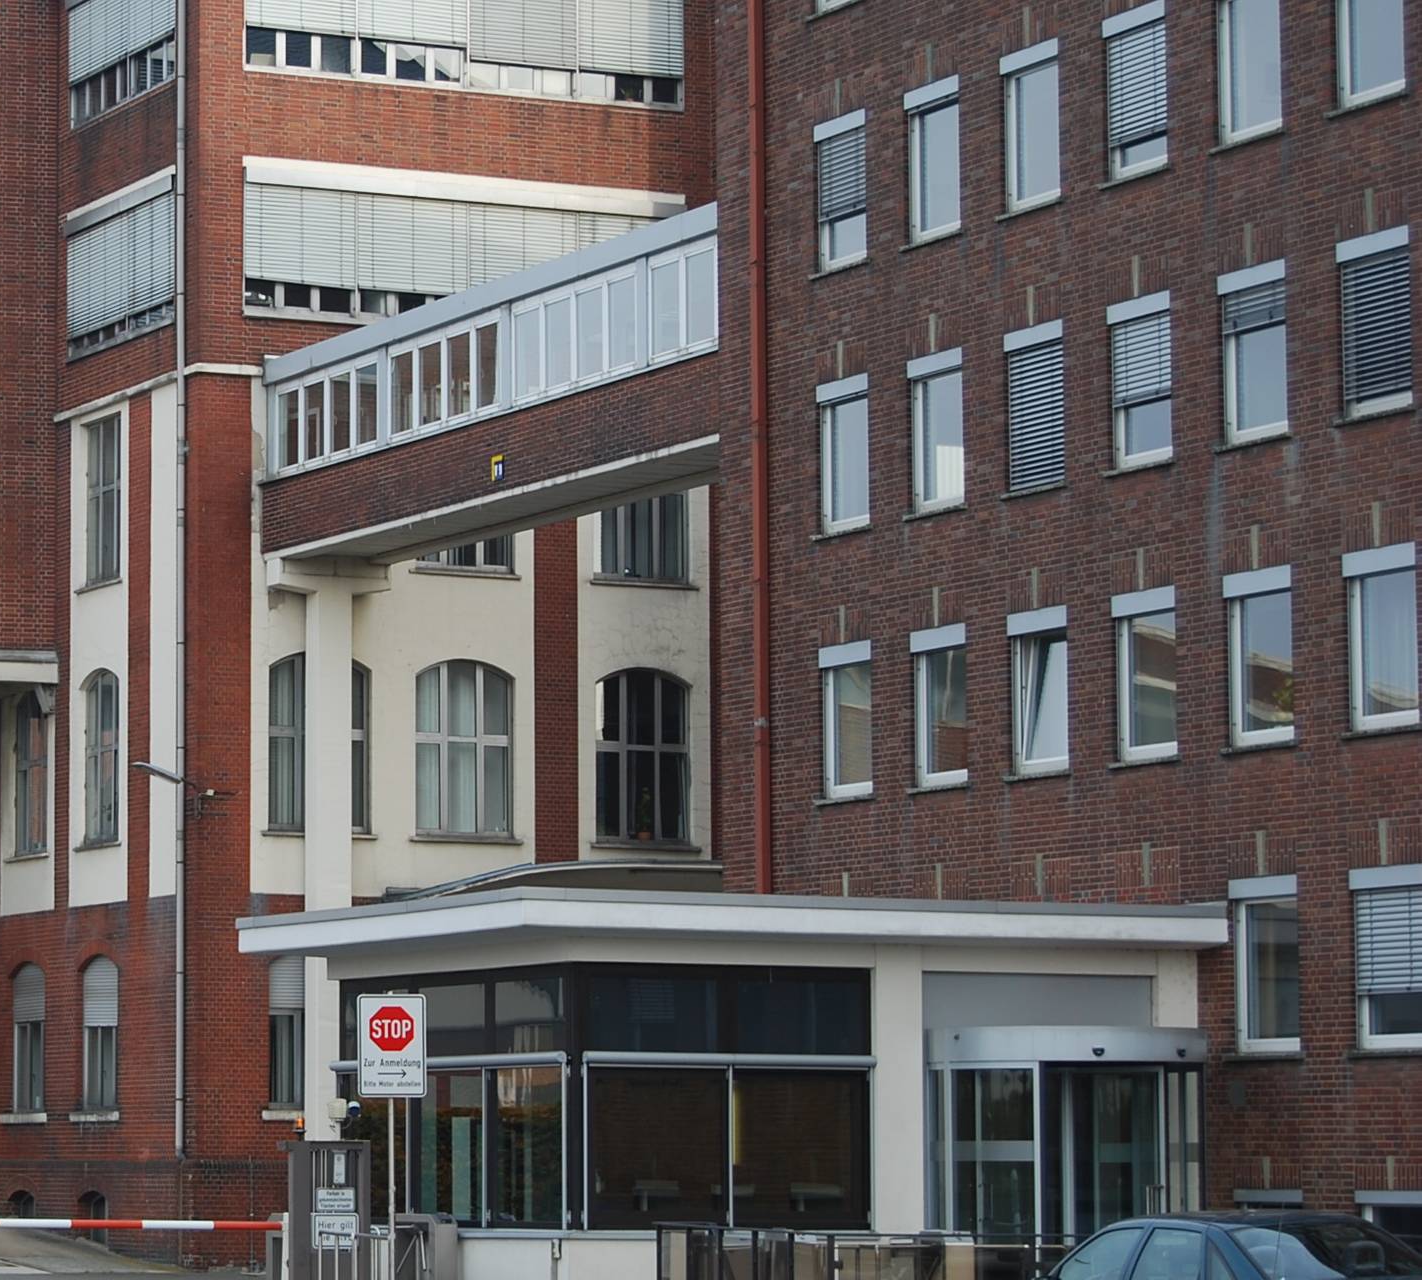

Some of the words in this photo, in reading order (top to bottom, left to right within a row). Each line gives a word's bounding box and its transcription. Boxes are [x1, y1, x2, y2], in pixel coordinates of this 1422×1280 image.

[371, 1019, 412, 1039] STOP
[363, 1058, 376, 1067] Zur
[379, 1058, 421, 1069] Anmeldung
[318, 1221, 336, 1229] Hier
[340, 1221, 354, 1231] gilt
